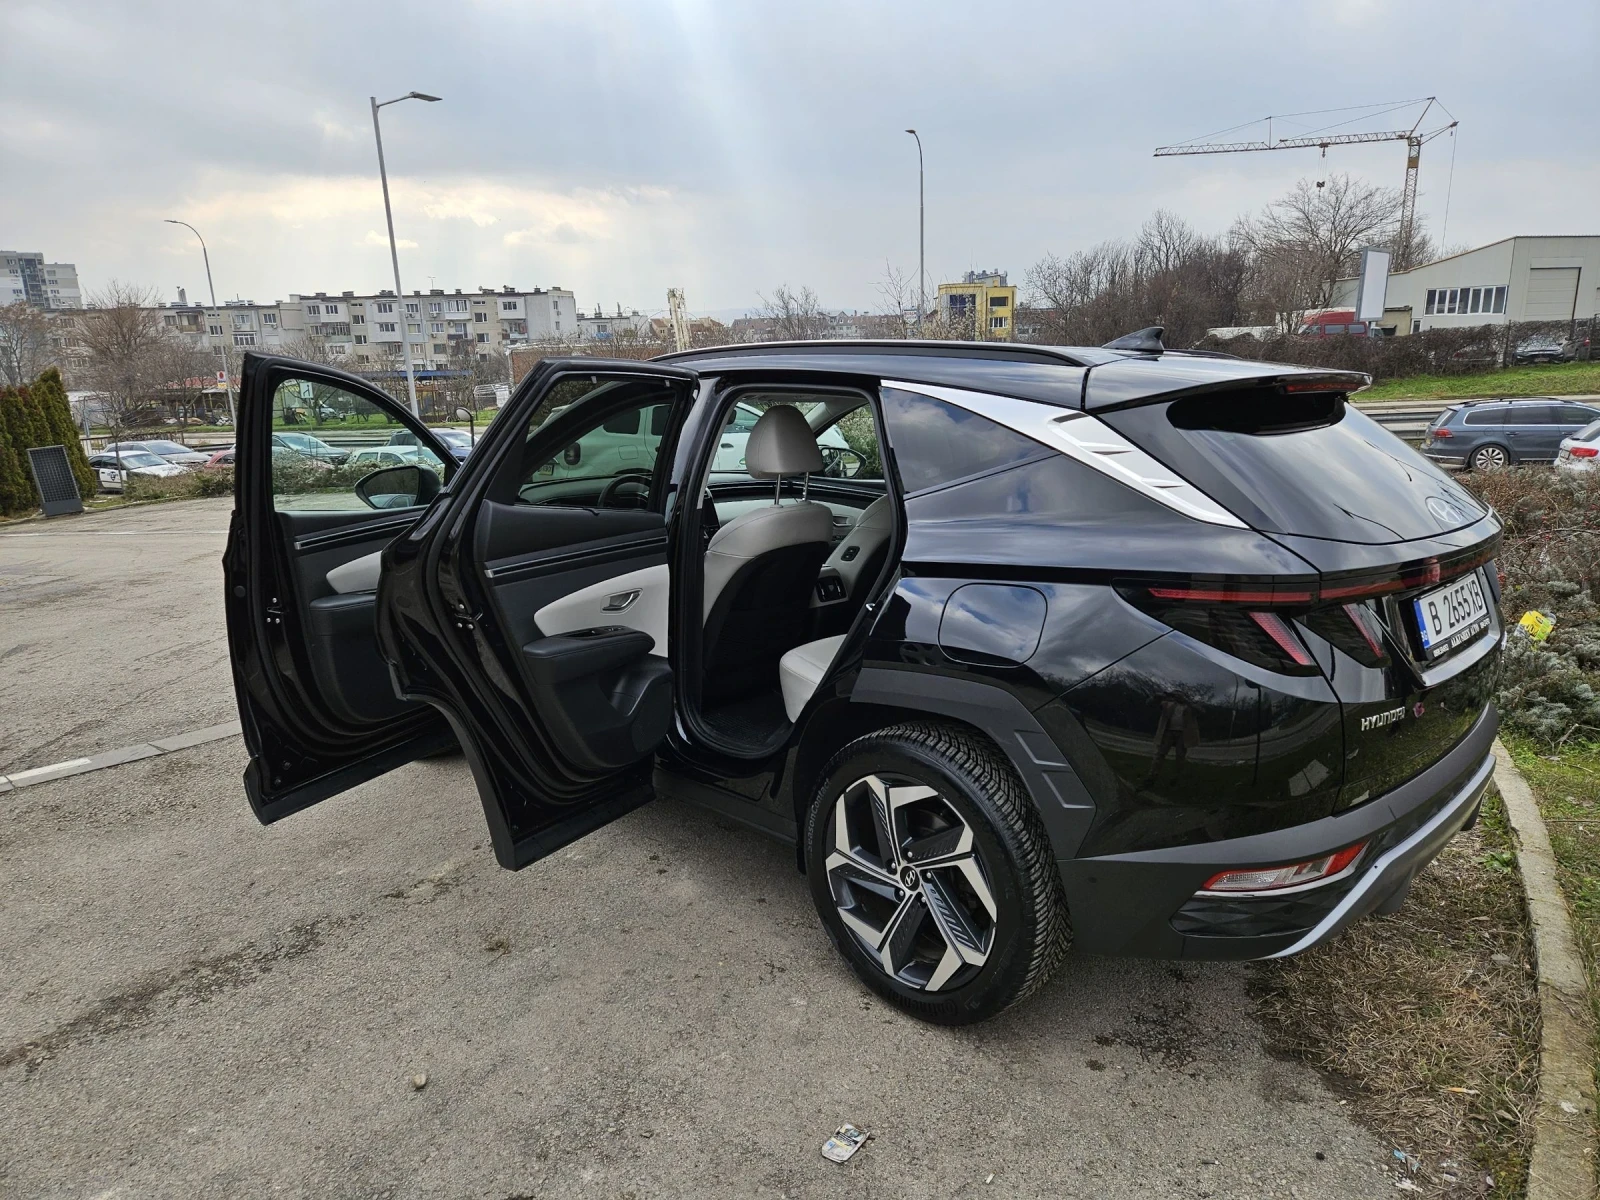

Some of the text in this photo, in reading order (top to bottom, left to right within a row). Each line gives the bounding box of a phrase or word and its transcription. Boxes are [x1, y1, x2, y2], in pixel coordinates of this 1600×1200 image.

[1428, 579, 1483, 636] B 2655 XB
[1361, 706, 1406, 731] HYUNDAI
